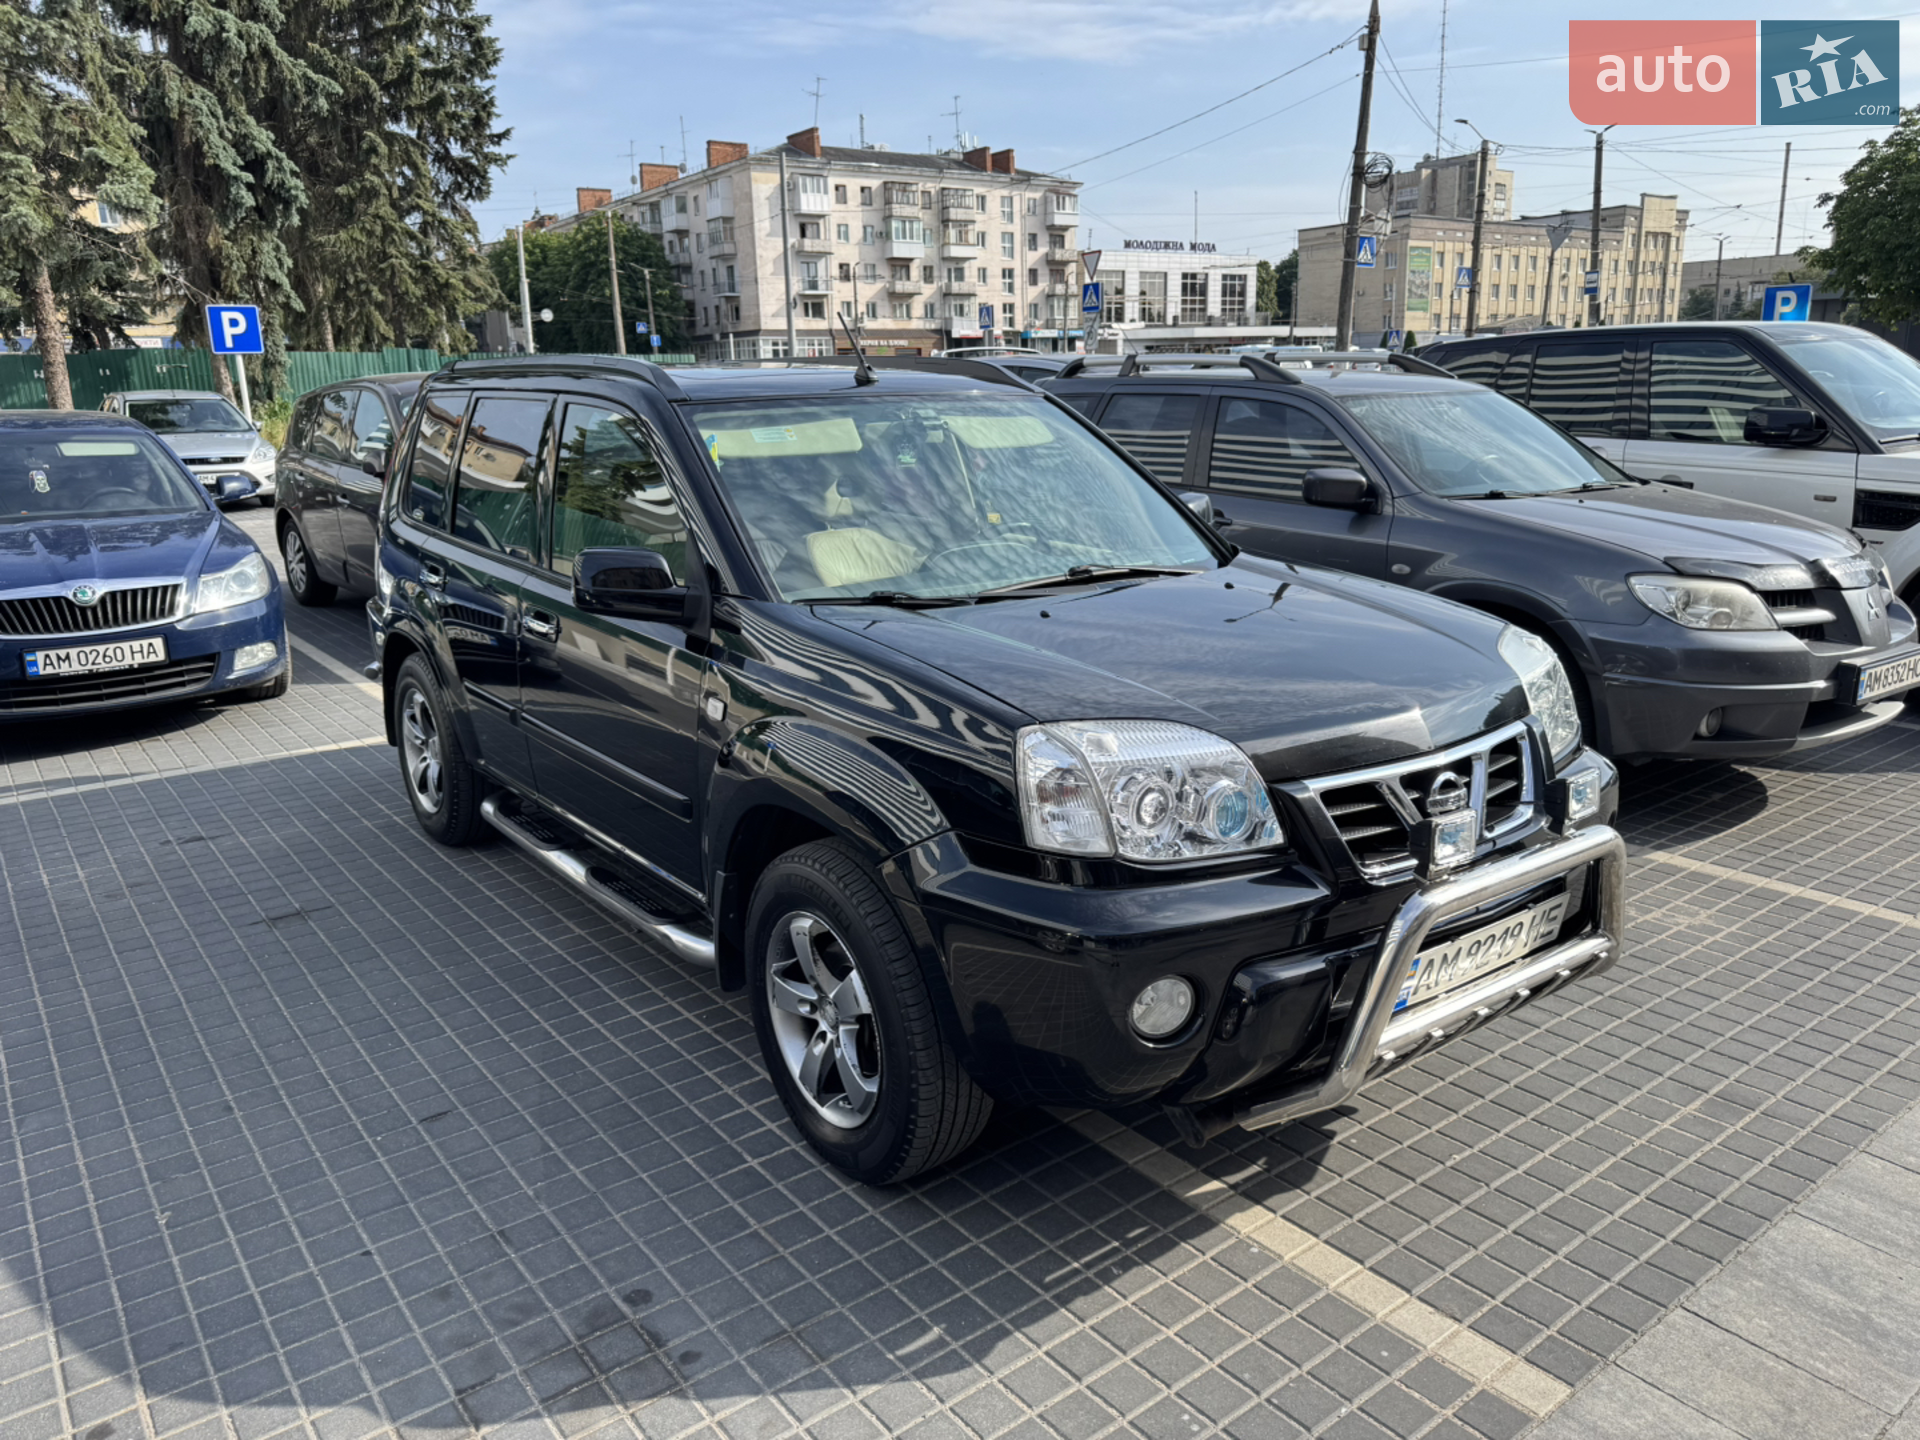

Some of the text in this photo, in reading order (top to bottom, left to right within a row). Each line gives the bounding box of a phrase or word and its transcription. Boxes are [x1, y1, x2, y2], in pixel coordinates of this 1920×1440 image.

[1123, 239, 1217, 253] МОЛОДІЖНА МОДА
[1773, 290, 1797, 321] P
[220, 311, 247, 349] P
[42, 651, 72, 671] AM
[76, 646, 125, 667] 0260
[129, 642, 159, 661] HA
[1864, 669, 1883, 693] AM
[1882, 662, 1907, 687] 8352
[1412, 902, 1563, 995] AM 9219 HE
